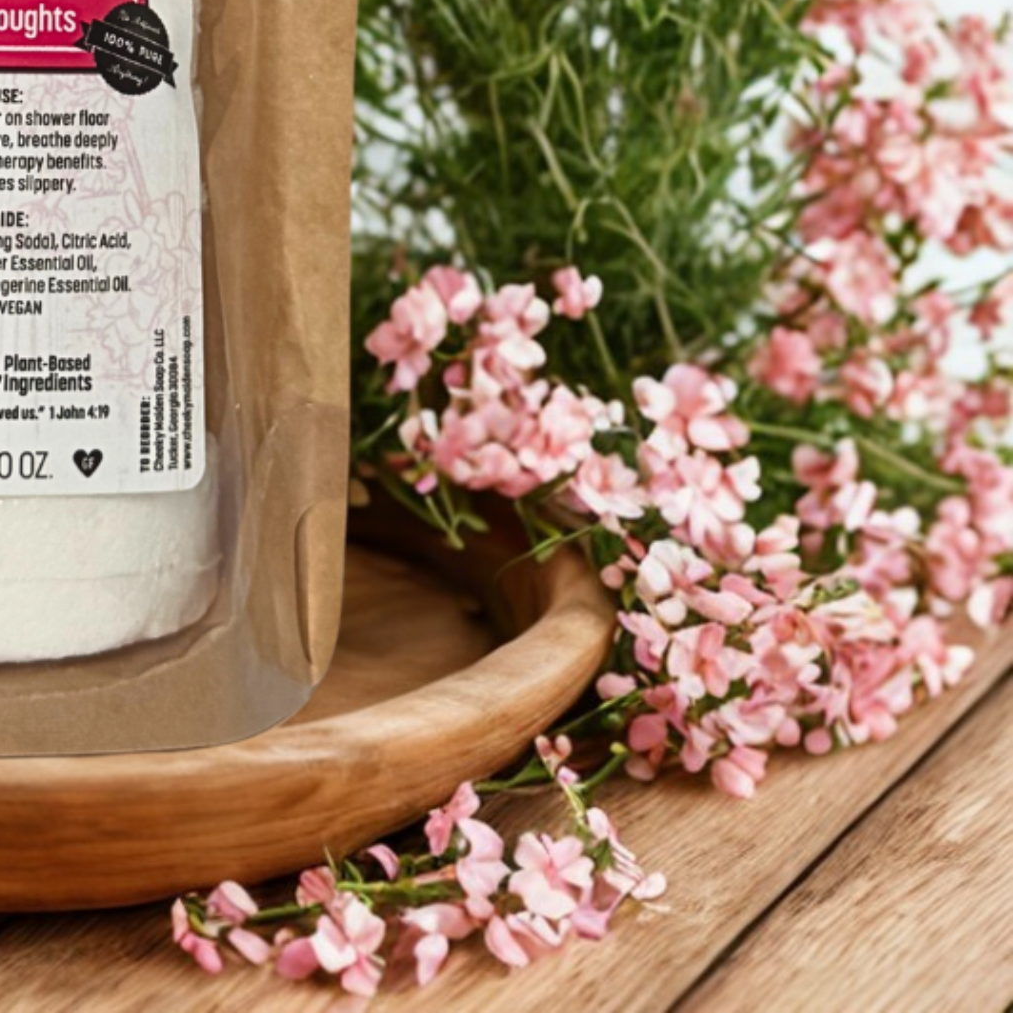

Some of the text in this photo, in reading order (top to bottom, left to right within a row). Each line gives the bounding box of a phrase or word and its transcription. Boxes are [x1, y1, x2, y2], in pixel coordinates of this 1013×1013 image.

[104, 31, 134, 53] 100%
[5, 113, 23, 126] on
[25, 110, 75, 127] shower
[78, 110, 109, 127] floor
[17, 132, 71, 148] breathe
[74, 133, 118, 151] deeply
[46, 153, 107, 170] benefits.
[17, 175, 77, 194] slippery.
[62, 233, 97, 249] Citric
[99, 232, 131, 250] Acid,
[11, 254, 74, 271] Essential
[77, 254, 97, 272] Oil,
[48, 276, 110, 294] Essential
[112, 275, 131, 292] Oil.
[4, 353, 91, 372] Plant-Based
[3, 373, 93, 396] Ingredients
[50, 406, 55, 419] 1
[56, 406, 86, 420] John
[87, 405, 110, 419] 4:19
[19, 451, 53, 479] OZ.
